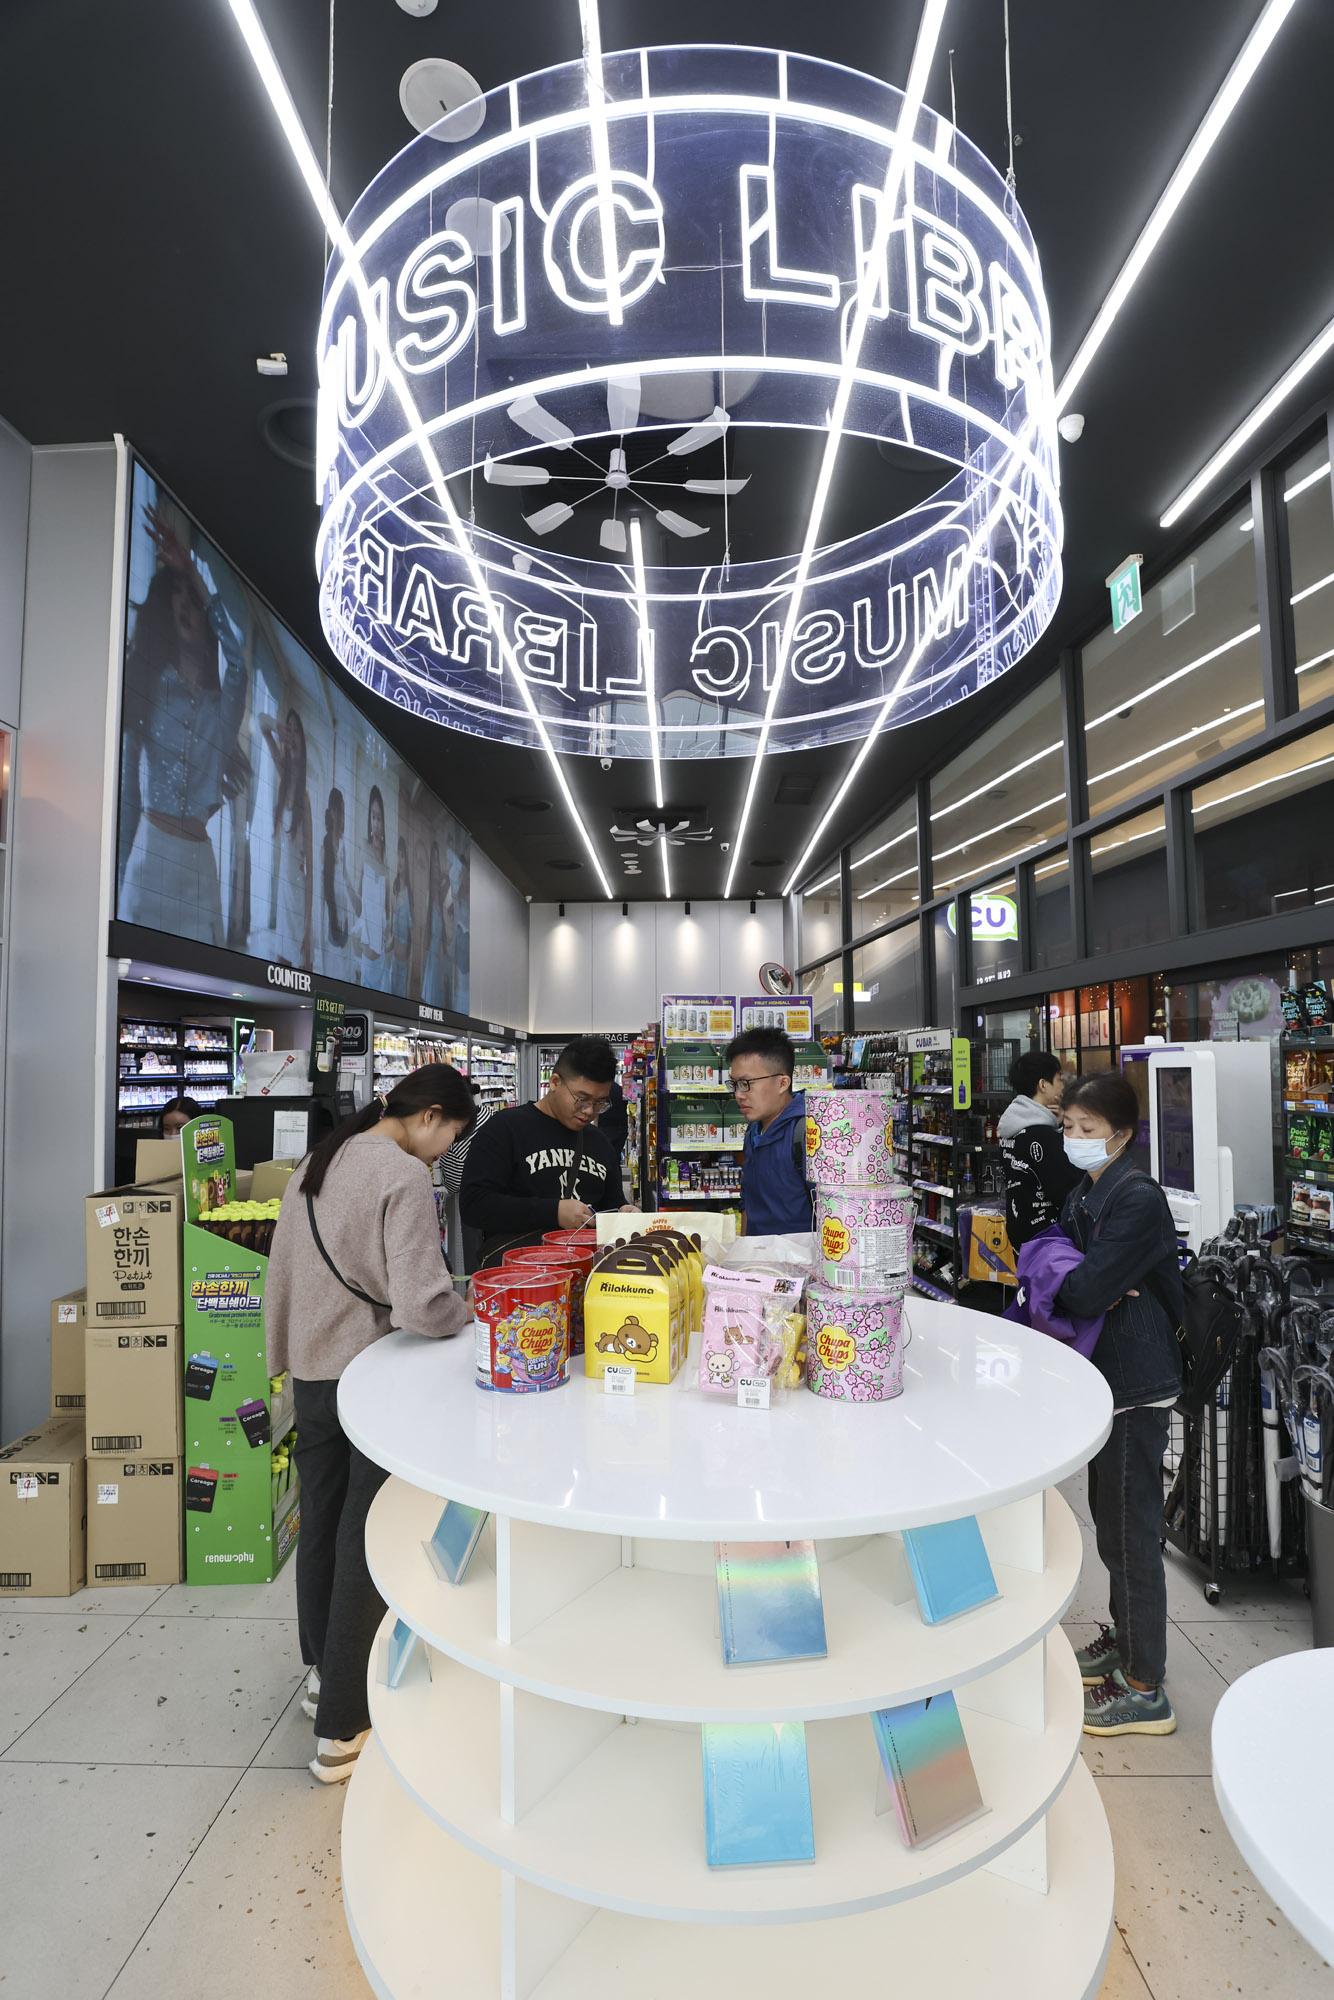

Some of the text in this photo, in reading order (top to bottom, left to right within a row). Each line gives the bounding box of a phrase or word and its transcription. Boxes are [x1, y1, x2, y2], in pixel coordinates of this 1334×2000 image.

[320, 164, 1045, 428] USIC LIBR
[971, 905, 1006, 928] CU
[267, 965, 311, 992] COUNTER
[316, 999, 329, 1012] LET'S
[329, 1002, 338, 1013] GET
[418, 1005, 433, 1020] READY
[525, 1148, 608, 1182] YANKEES
[113, 1227, 151, 1248] 한손
[822, 1225, 846, 1240] Chupa
[822, 1237, 845, 1251] Chups
[113, 1248, 151, 1269] 한끼
[112, 1270, 153, 1282] Petit
[191, 1280, 248, 1297] 한손한끼
[600, 1281, 654, 1295] Rilakkuma
[197, 1296, 261, 1309] 단백질쉐이크
[521, 1326, 554, 1339] Chupa
[520, 1337, 553, 1350] Chups
[819, 1333, 851, 1348] Chupa
[527, 1355, 546, 1364] FOREVER
[818, 1345, 849, 1360] Chups
[527, 1361, 548, 1372] FUN
[740, 1379, 752, 1387] CU
